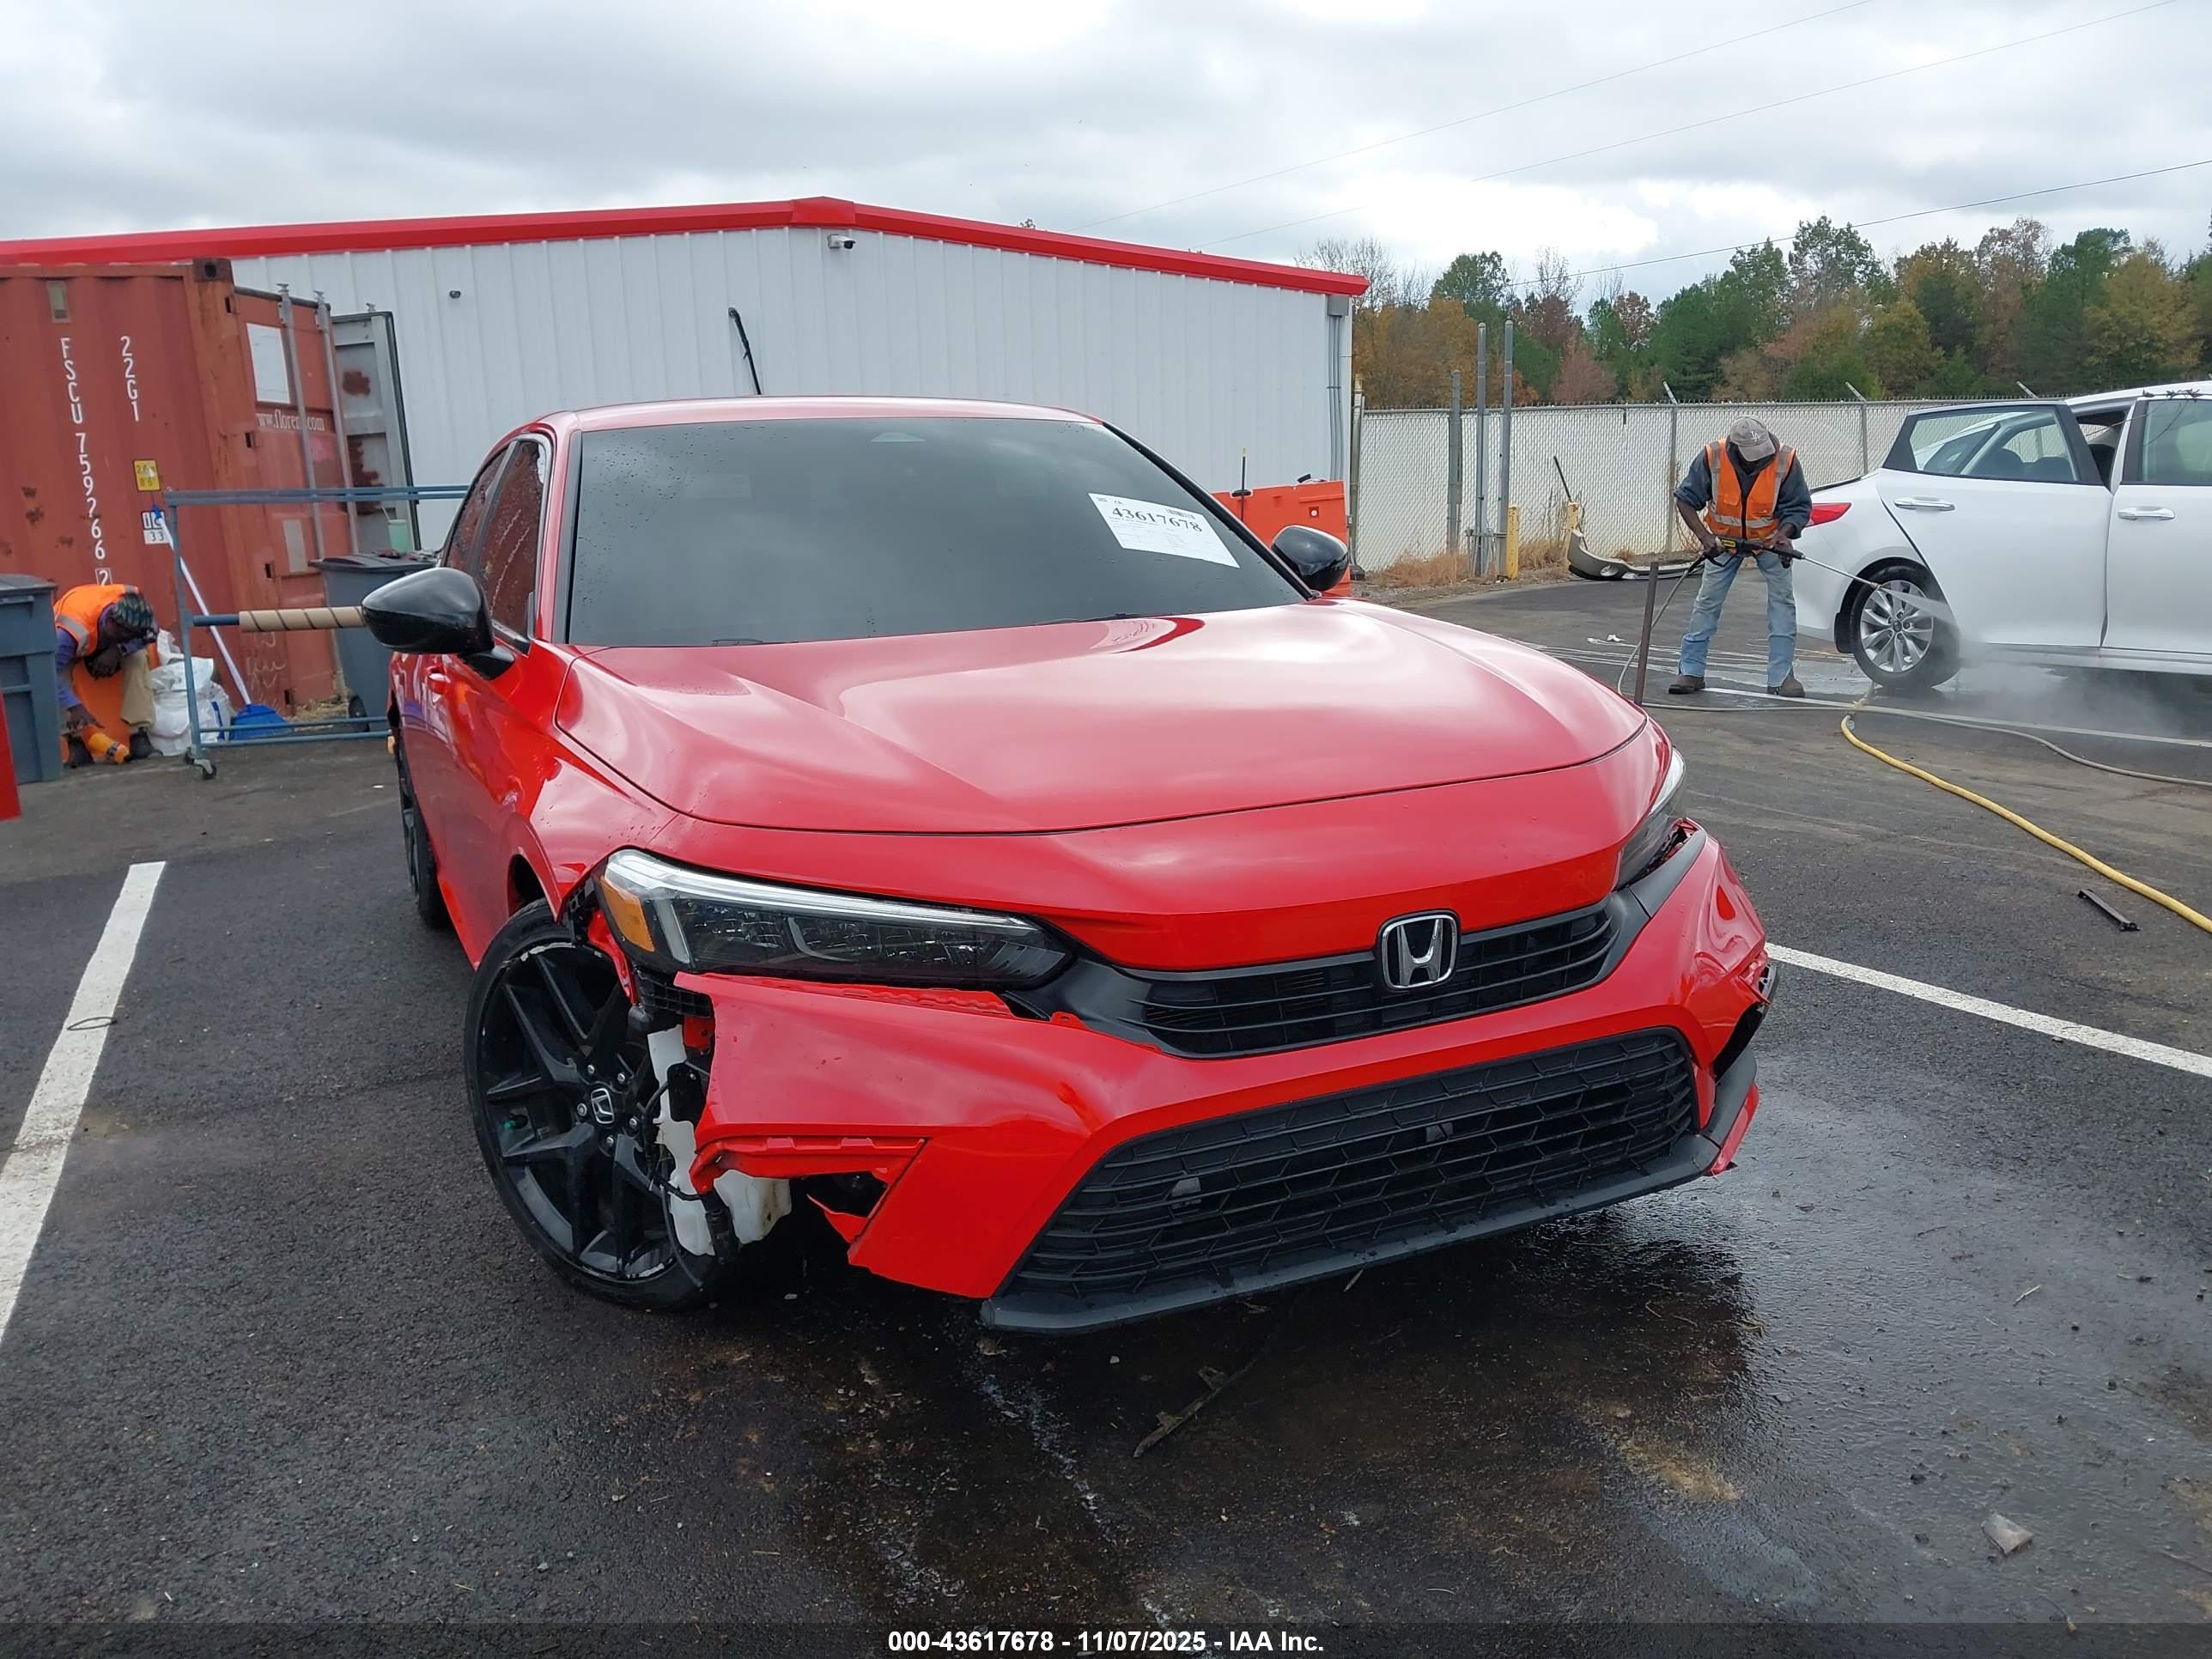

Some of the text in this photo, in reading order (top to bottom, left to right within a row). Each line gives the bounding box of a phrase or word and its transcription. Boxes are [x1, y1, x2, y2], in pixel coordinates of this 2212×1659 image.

[60, 337, 82, 424] FSCU
[120, 336, 139, 422] 22G1
[150, 532, 164, 542] 33
[1112, 507, 1203, 532] 43617678
